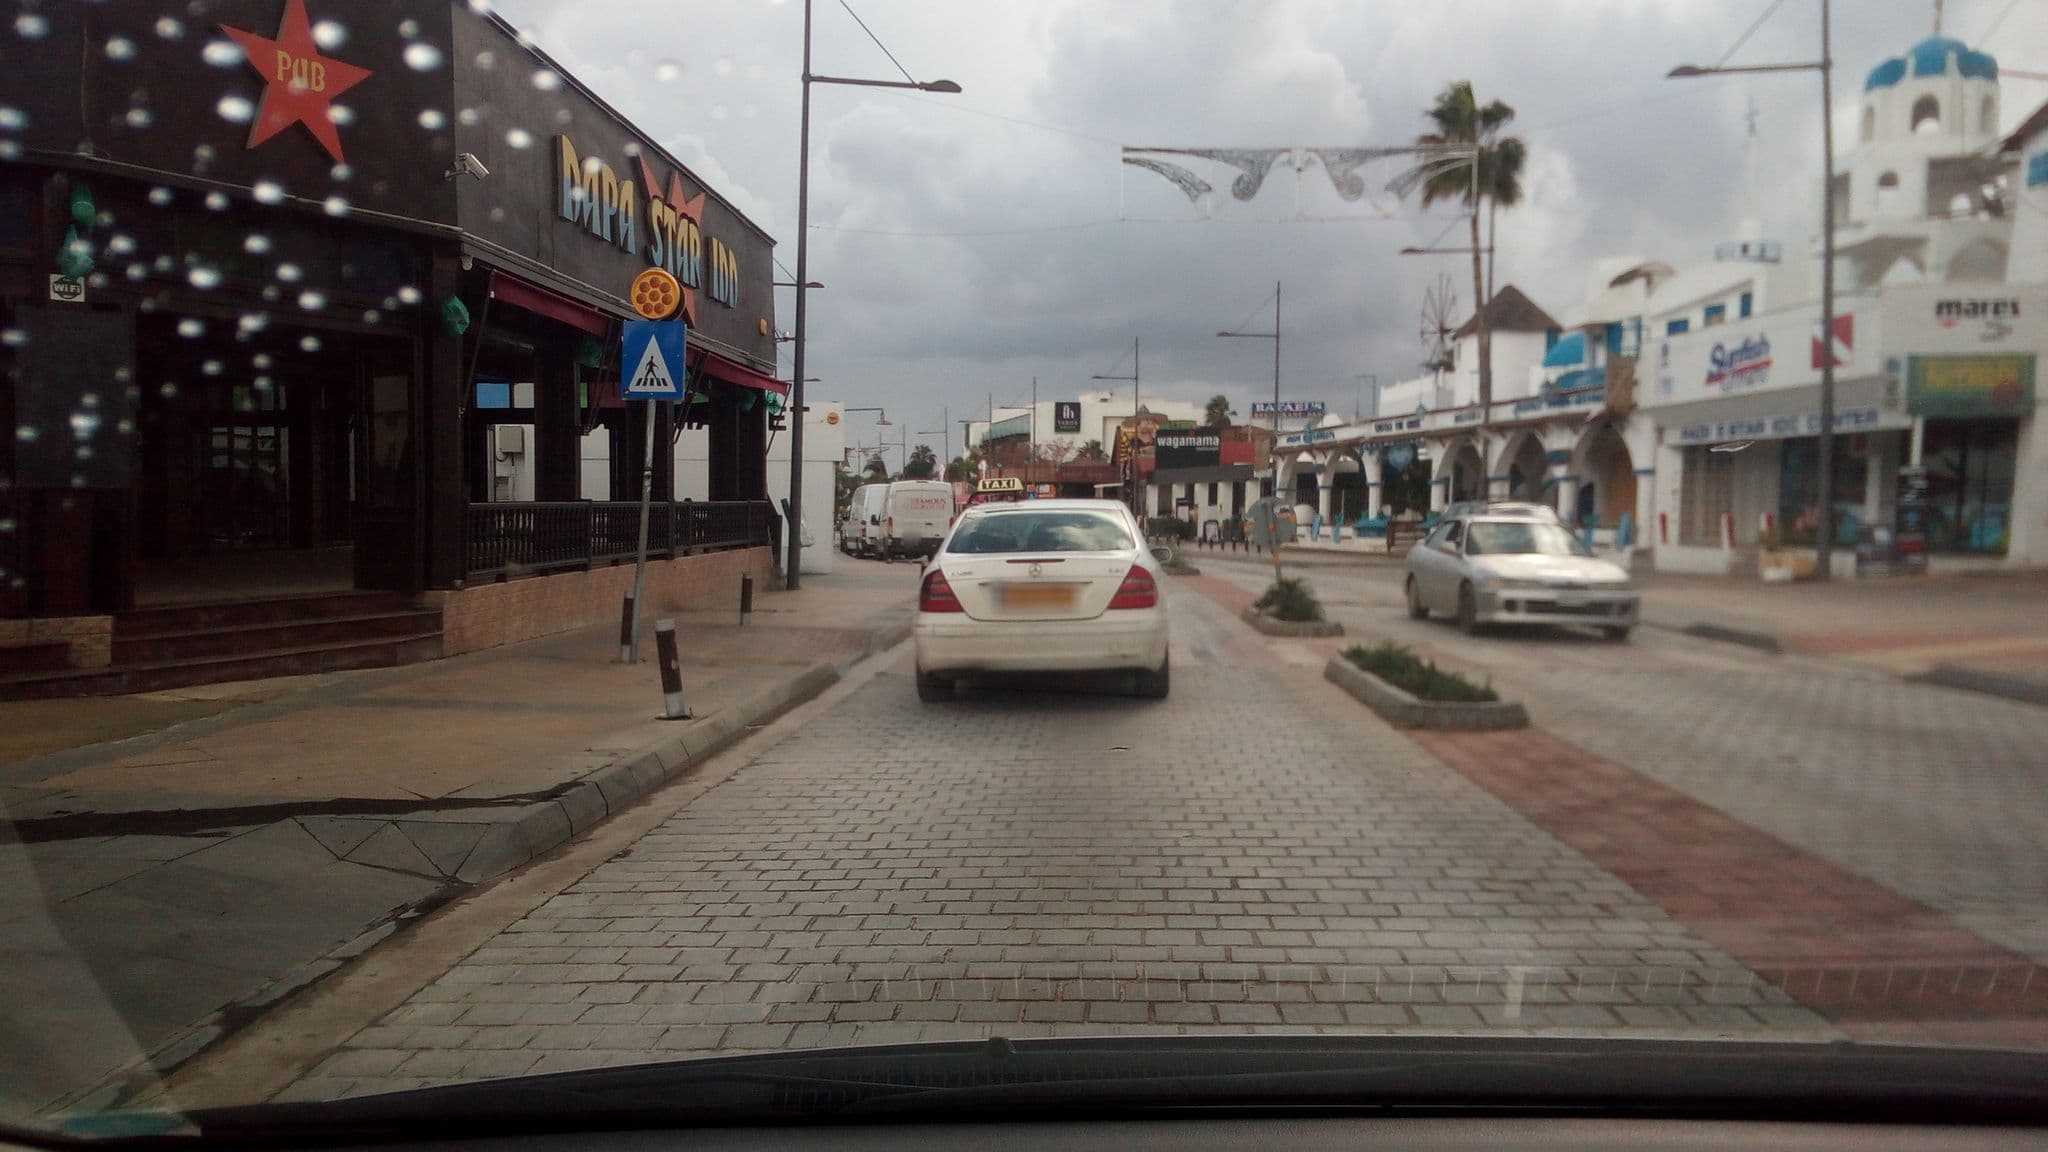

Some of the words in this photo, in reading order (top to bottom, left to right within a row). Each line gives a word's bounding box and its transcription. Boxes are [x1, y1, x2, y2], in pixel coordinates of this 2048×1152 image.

[276, 49, 325, 92] PUB
[559, 134, 636, 255] PAPA
[651, 200, 700, 289] STAR
[1157, 436, 1219, 449] wagamama
[983, 479, 1015, 490] TAXI
